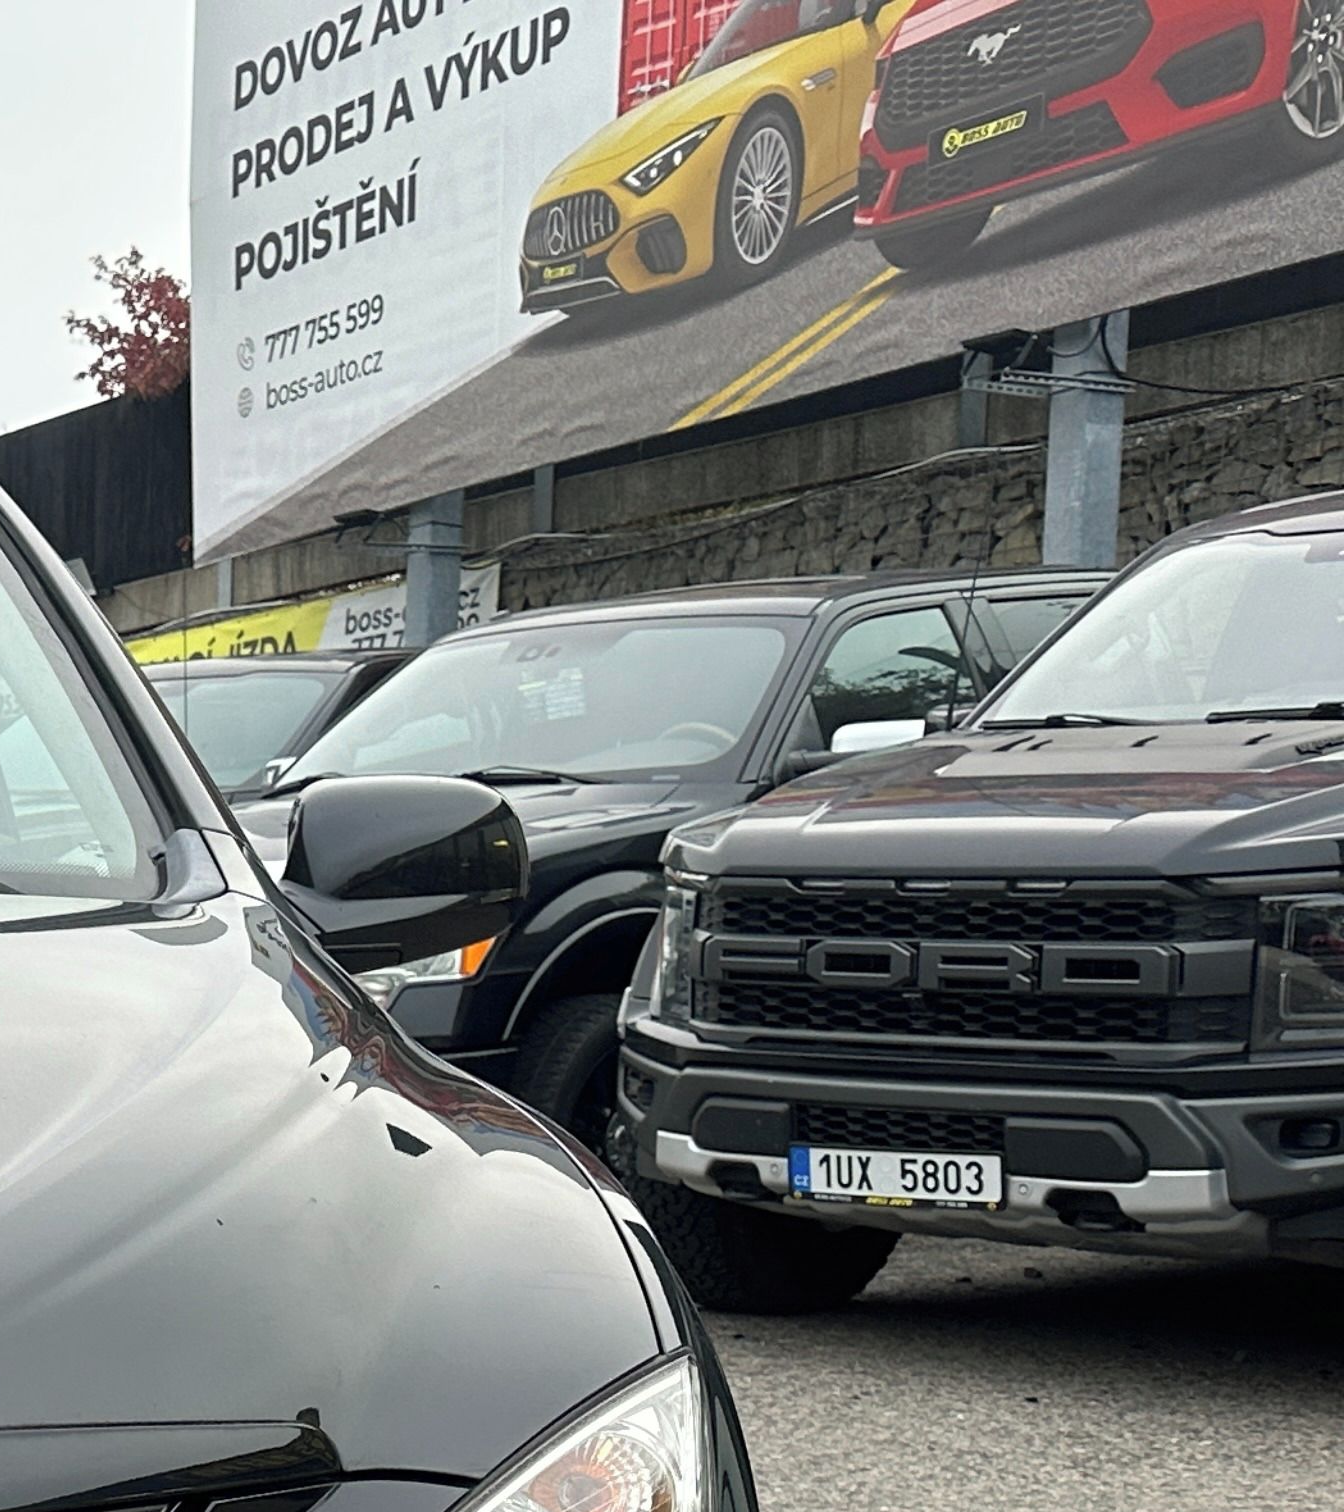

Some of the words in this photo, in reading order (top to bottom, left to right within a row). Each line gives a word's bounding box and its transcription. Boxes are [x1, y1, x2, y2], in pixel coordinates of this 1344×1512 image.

[234, 5, 363, 111] DOVOZ
[231, 90, 375, 197] PRODEJ
[384, 78, 415, 131] A
[424, 6, 571, 112] VÝKUP
[234, 158, 421, 291] POJIŠTĚNÍ
[264, 324, 301, 363] 777
[304, 309, 340, 349] 755
[345, 294, 384, 334] 599
[266, 350, 384, 410] boss-auto.cz
[703, 935, 1173, 997] FORD
[819, 1154, 873, 1191] 1UX
[900, 1158, 984, 1196] 5803
